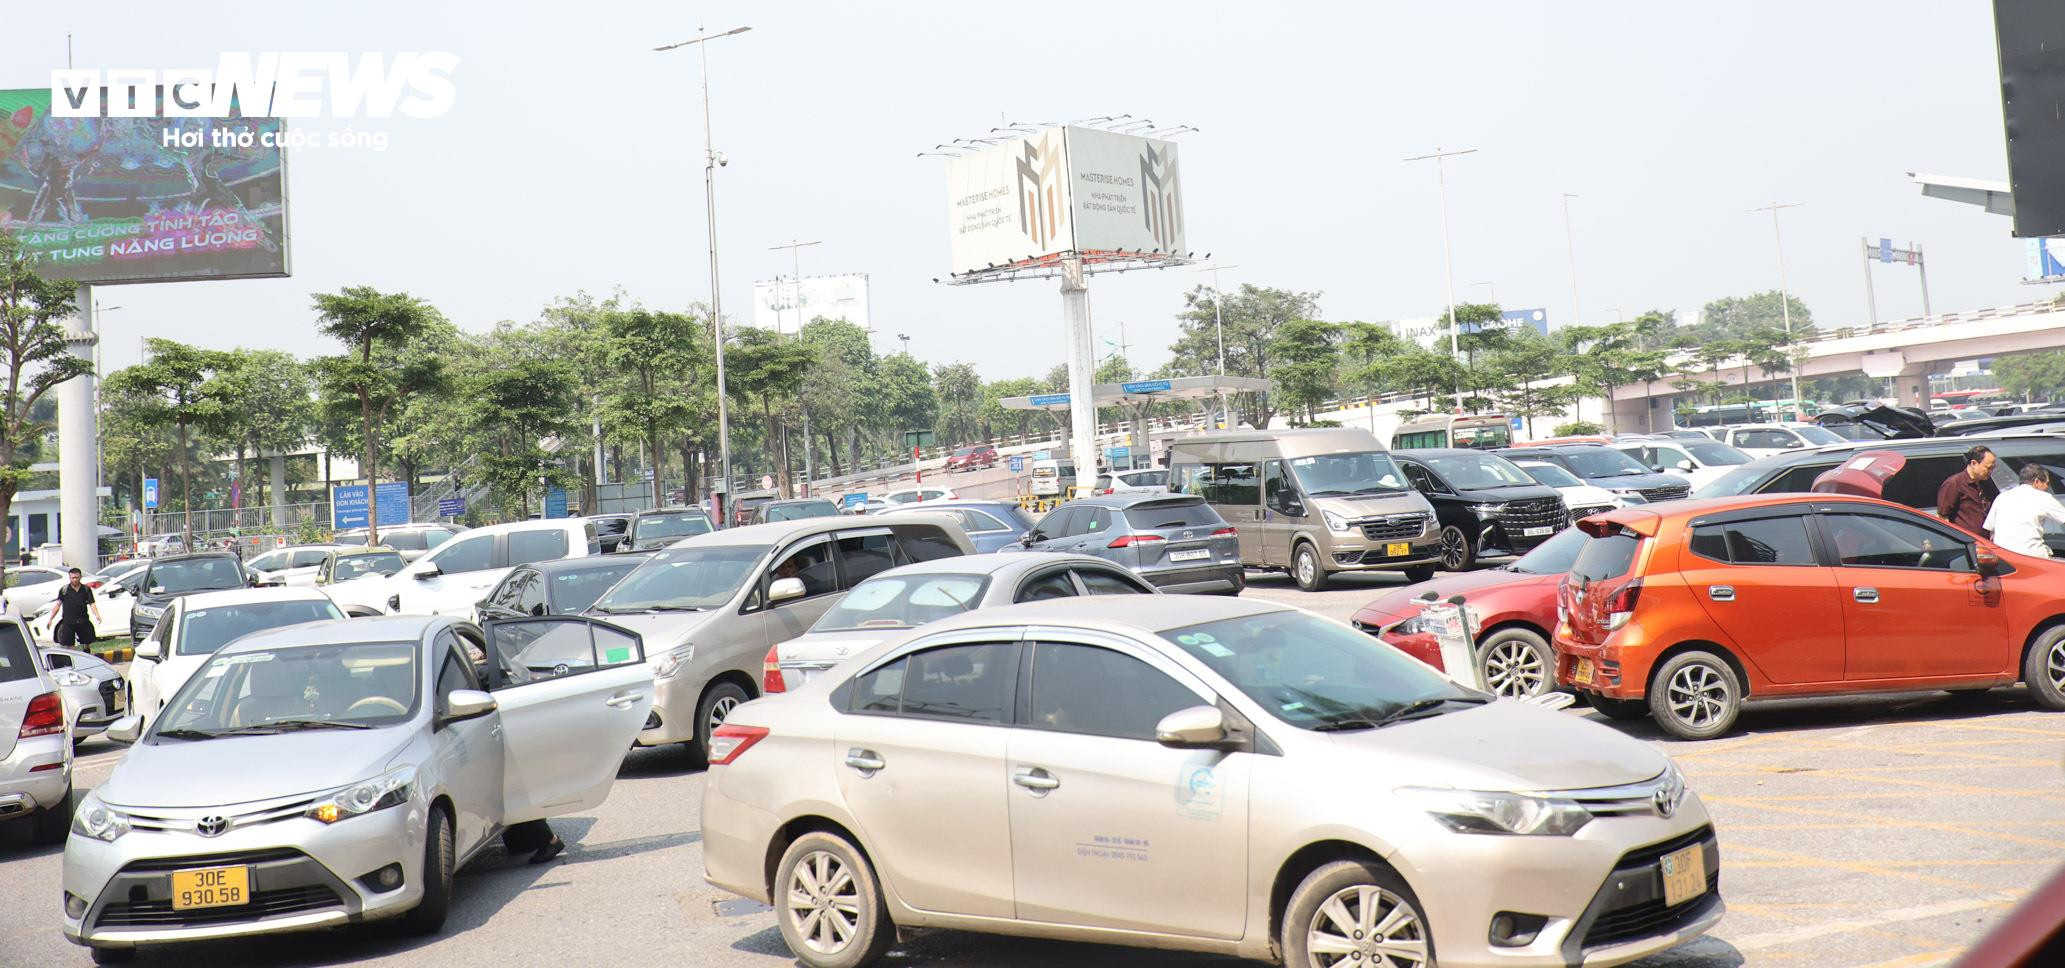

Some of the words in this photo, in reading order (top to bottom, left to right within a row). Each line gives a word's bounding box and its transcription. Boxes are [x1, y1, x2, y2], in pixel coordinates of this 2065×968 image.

[1080, 172, 1114, 185] MASTERISE
[1113, 175, 1135, 187] HOMES
[50, 245, 104, 261] TUNG
[110, 236, 175, 256] NĂNG
[1406, 325, 1437, 339] INAX
[194, 870, 226, 887] 30E
[182, 887, 240, 906] 930.58
